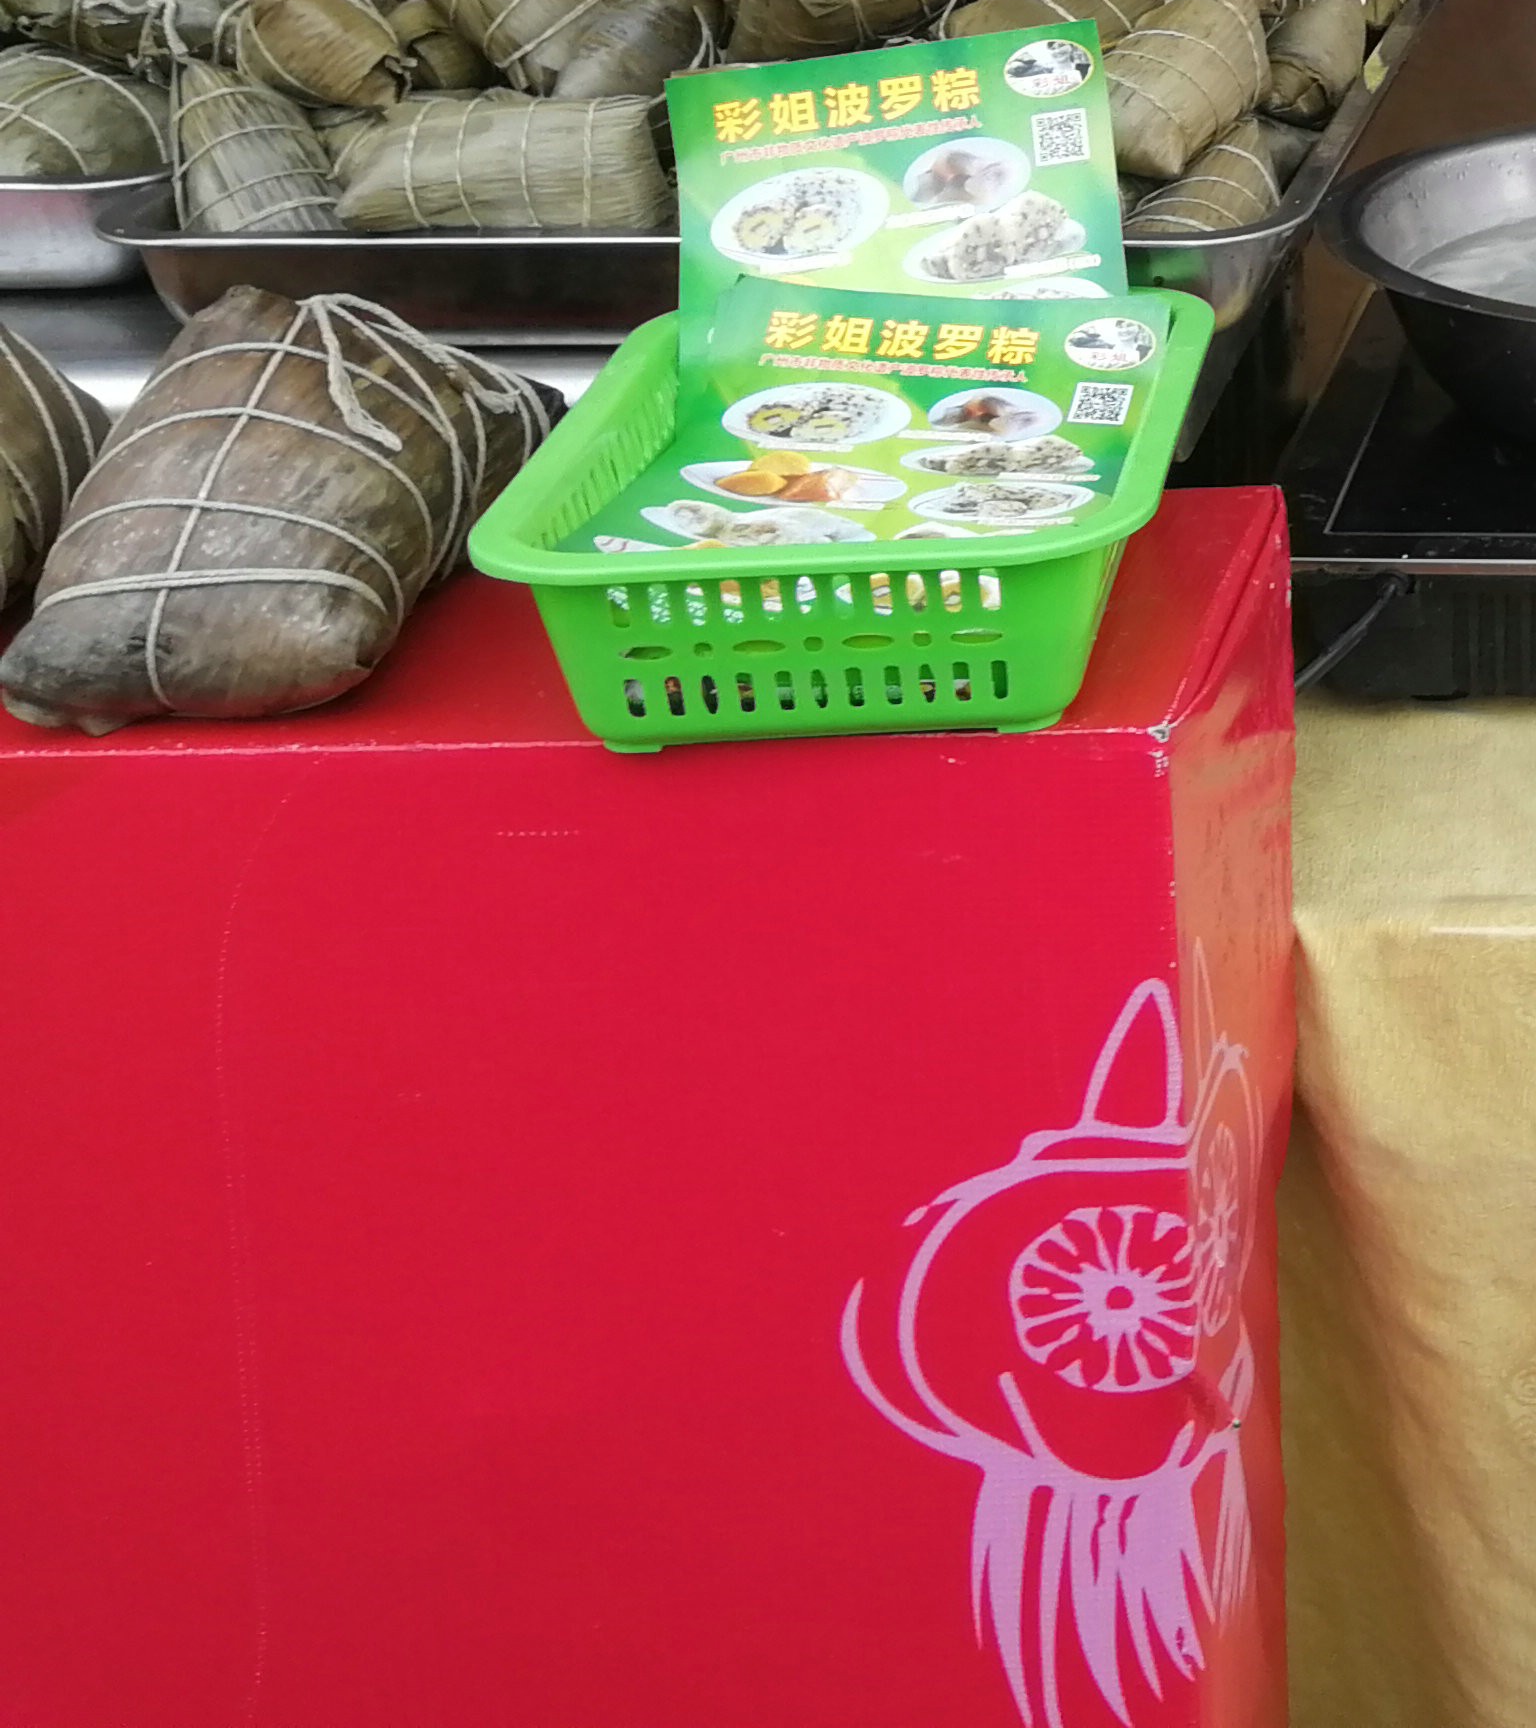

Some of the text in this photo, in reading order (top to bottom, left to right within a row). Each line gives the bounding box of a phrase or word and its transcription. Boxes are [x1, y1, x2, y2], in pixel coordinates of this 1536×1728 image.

[712, 66, 983, 145] 彩姐波罗粽
[763, 310, 1040, 366] 彩姐波罗粽
